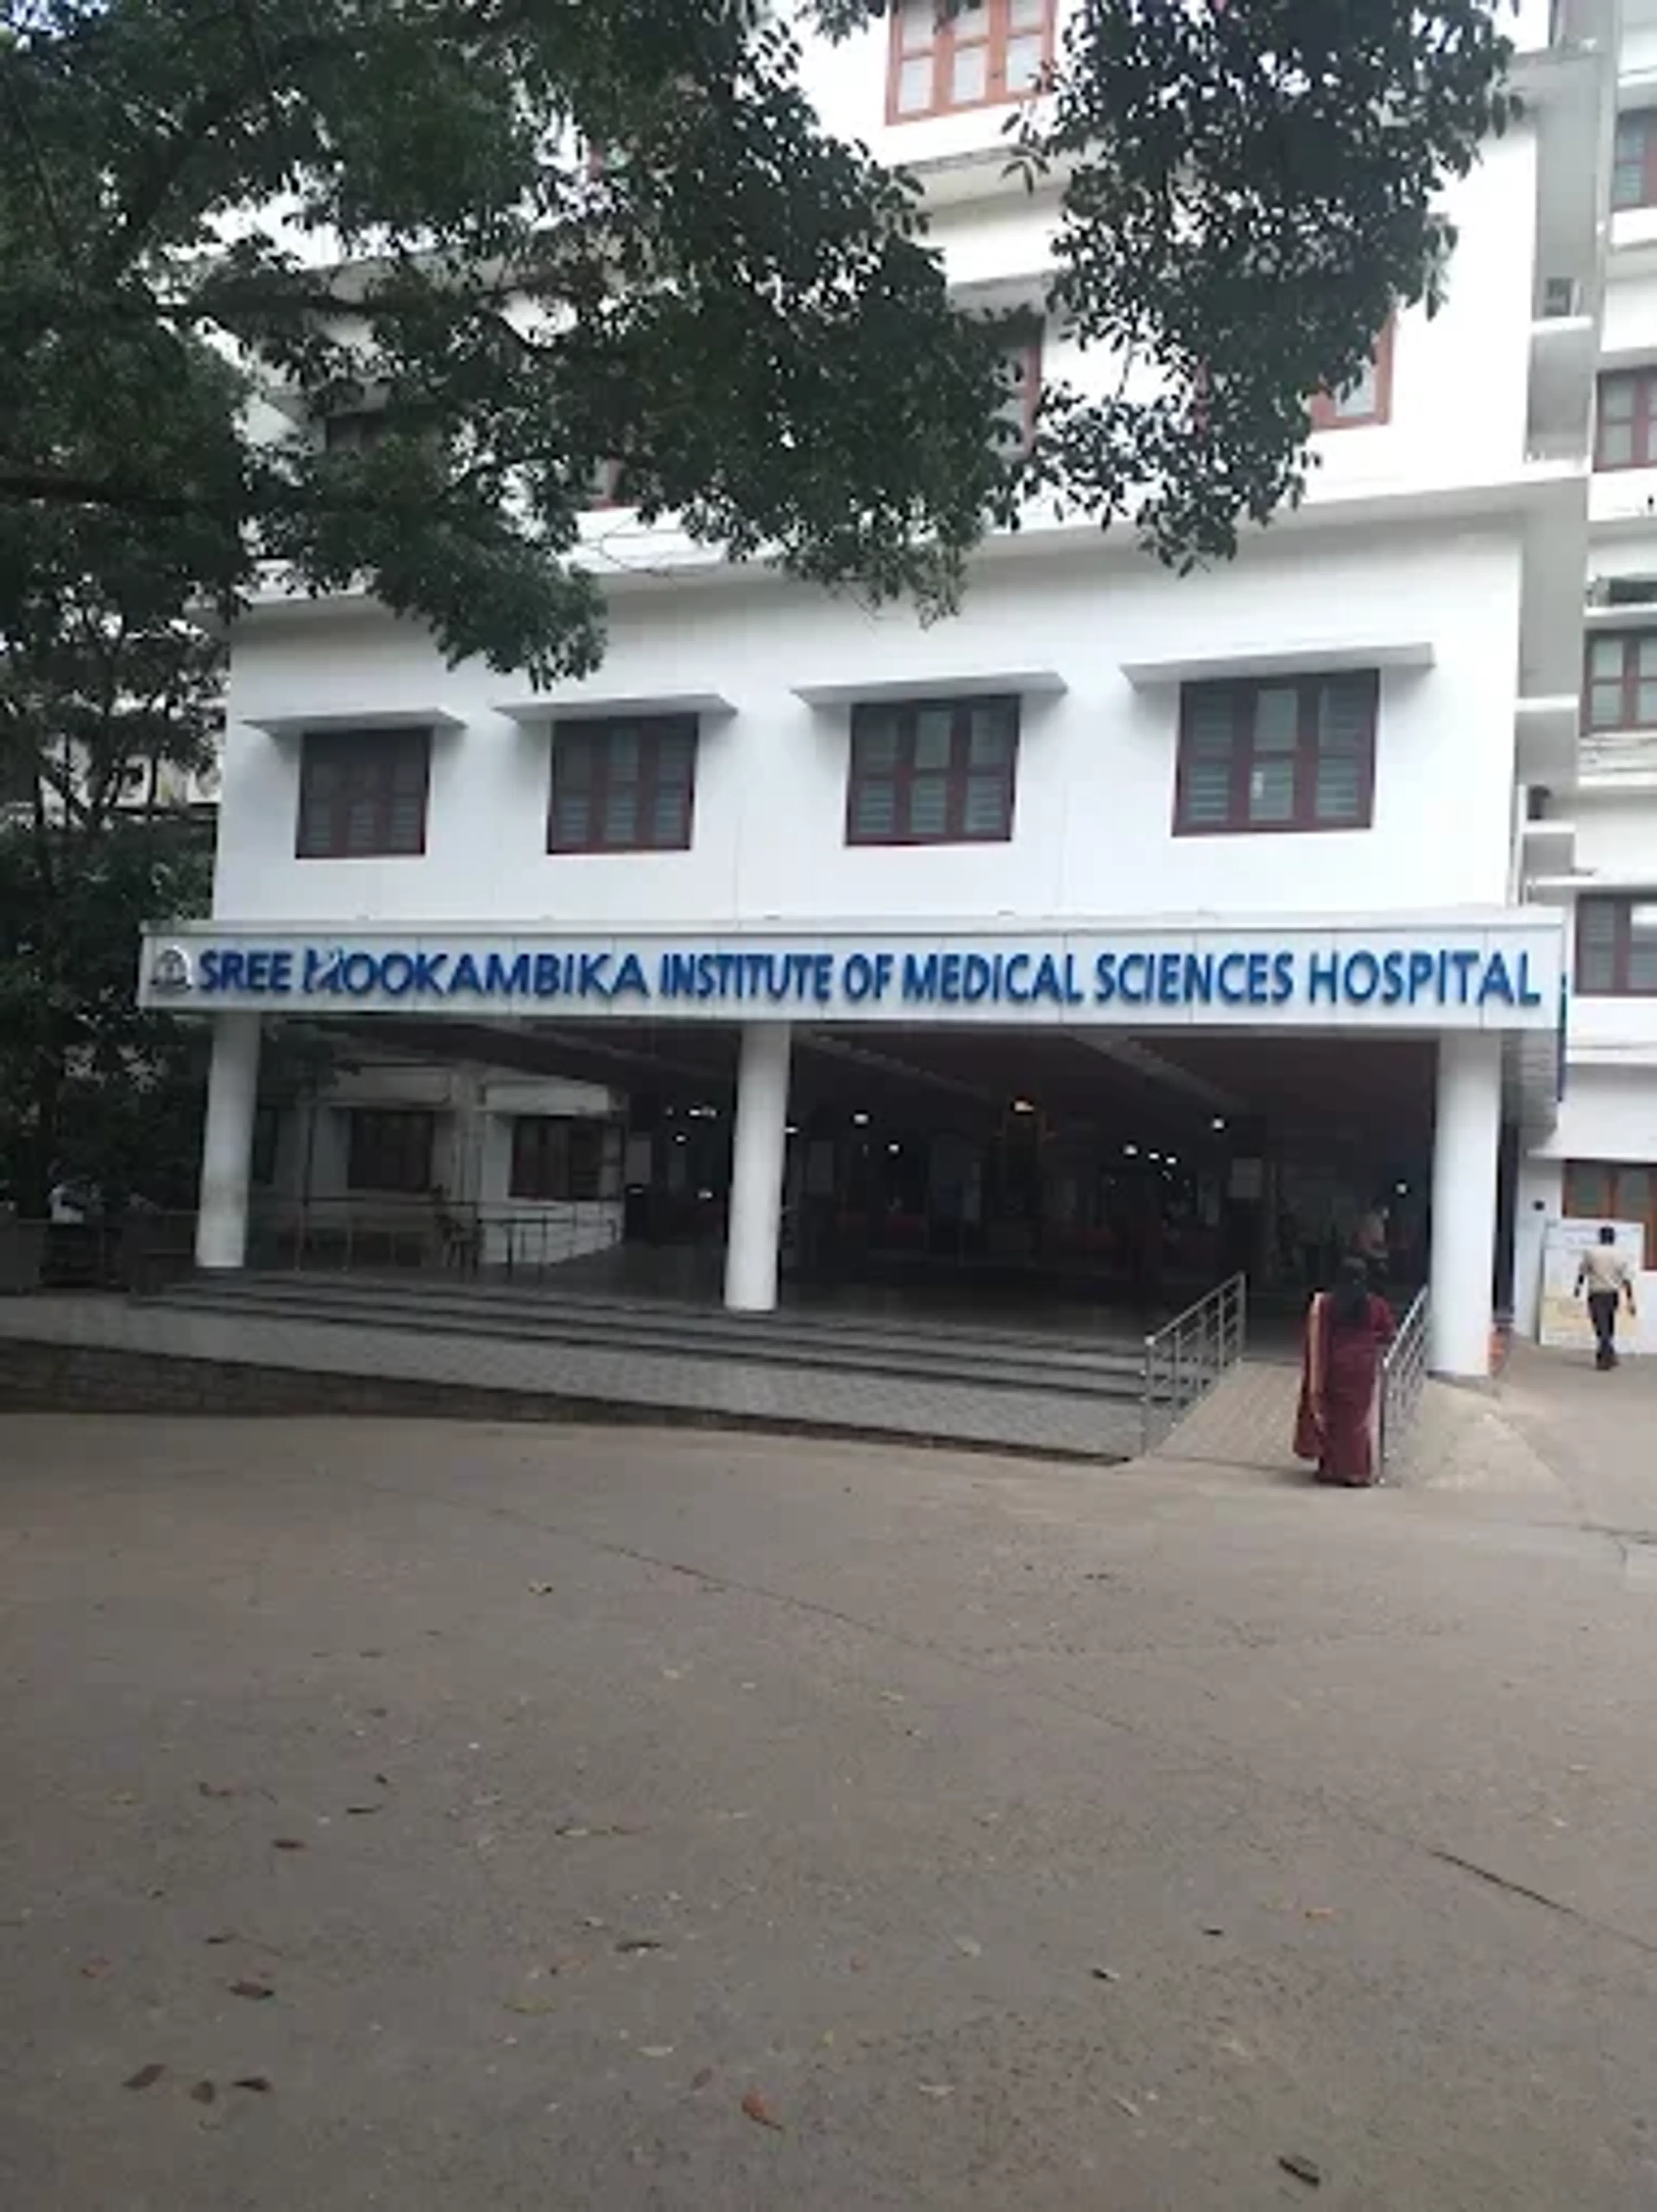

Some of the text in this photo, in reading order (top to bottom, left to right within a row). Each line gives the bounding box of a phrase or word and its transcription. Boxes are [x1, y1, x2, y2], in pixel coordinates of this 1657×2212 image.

[199, 950, 293, 991] SREE
[661, 954, 834, 1001] INSTITUTE
[844, 954, 894, 1001] OF
[903, 953, 1084, 1003] MEDICAL
[1095, 953, 1294, 1005] SCIENCES
[1307, 950, 1541, 1006] HOSPITAL
